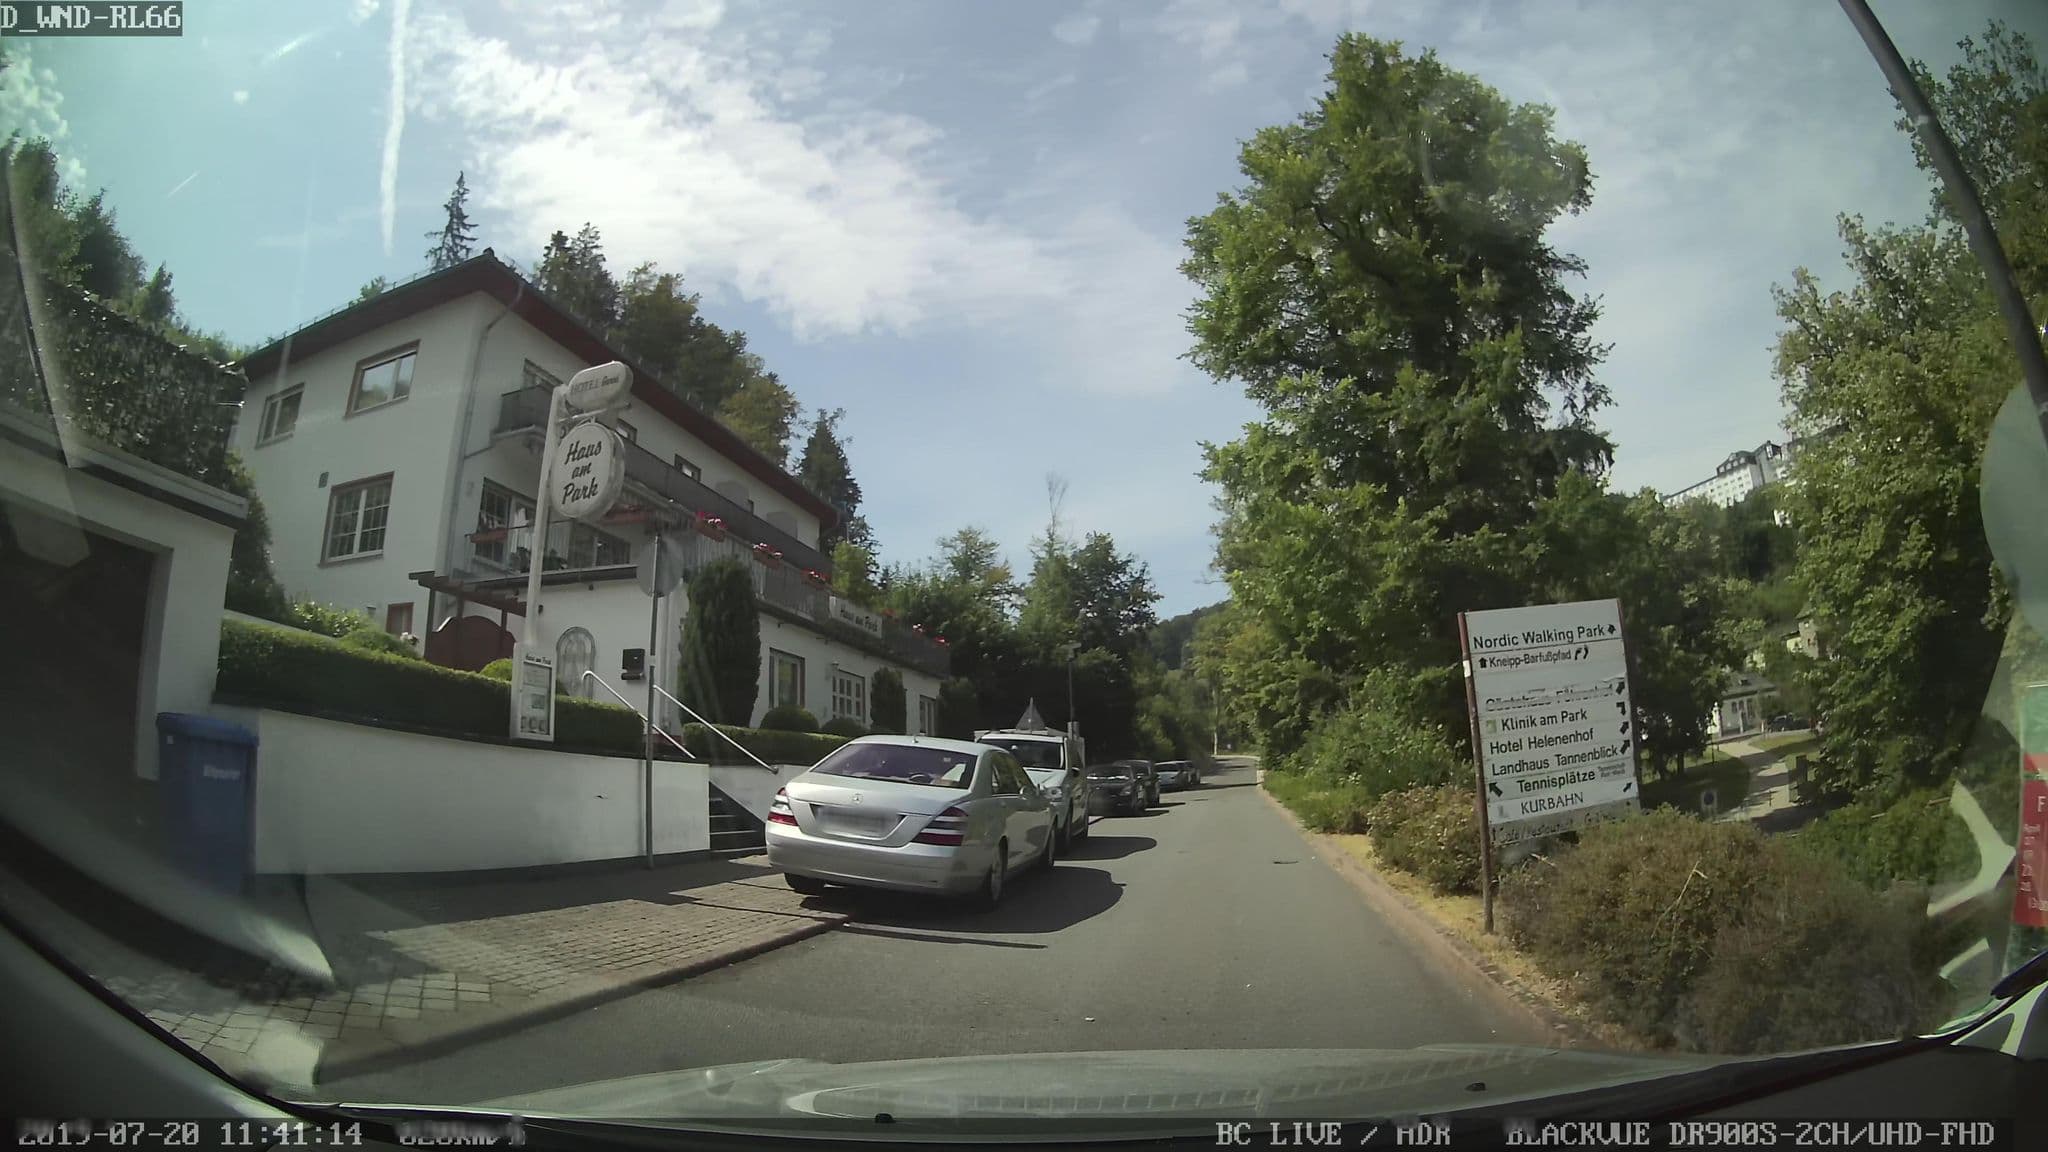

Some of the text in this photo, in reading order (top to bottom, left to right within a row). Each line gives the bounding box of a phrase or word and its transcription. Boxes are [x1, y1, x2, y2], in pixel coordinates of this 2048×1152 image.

[564, 440, 602, 465] Haus
[572, 462, 592, 479] am
[561, 477, 599, 505] Park
[1473, 624, 1605, 649] Nordic Walking Park
[1489, 649, 1572, 669] Kneipp-Barfußpfad
[1501, 708, 1588, 731] Klinik am Park
[1490, 728, 1594, 754] Hotel Helenenhof
[1492, 745, 1618, 776] Landhaus Tannenblick
[1517, 770, 1596, 793] Tennisplätze
[1521, 792, 1584, 815] KURBAHN
